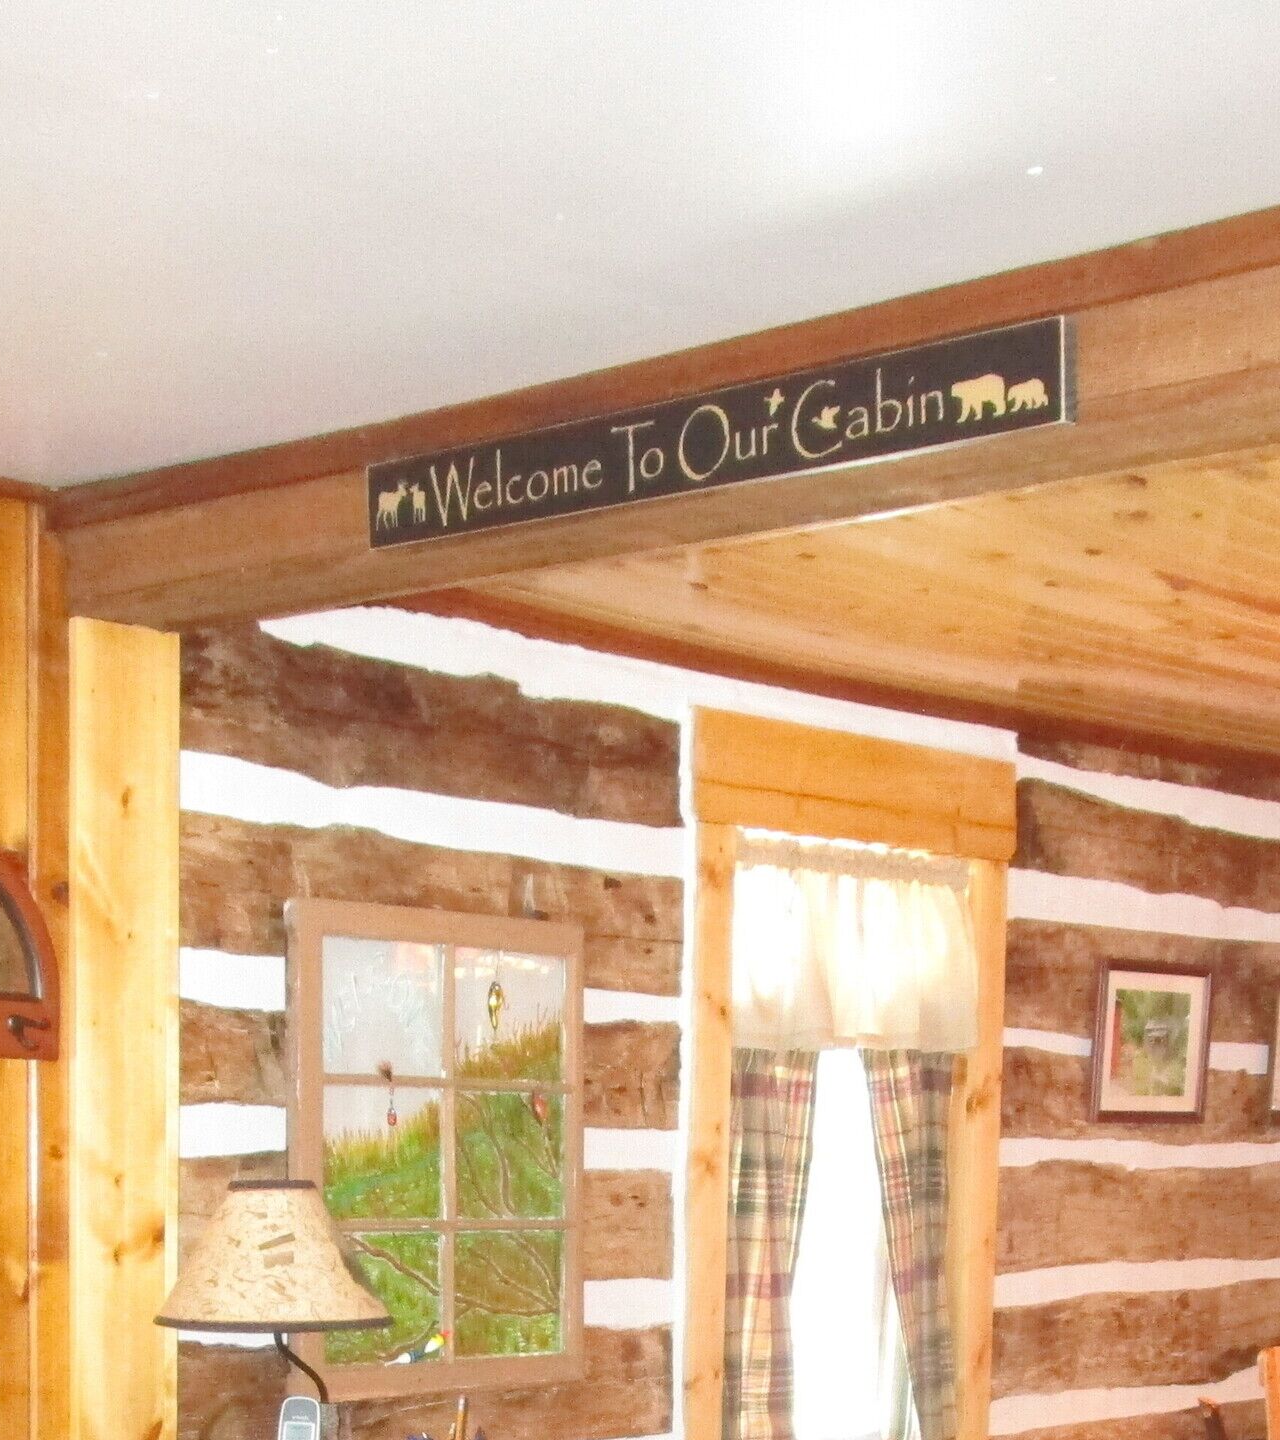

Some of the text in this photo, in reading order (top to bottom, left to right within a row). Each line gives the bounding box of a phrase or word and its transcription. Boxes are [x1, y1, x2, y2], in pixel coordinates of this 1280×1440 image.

[429, 367, 945, 527] Welcome To Our Cabin
